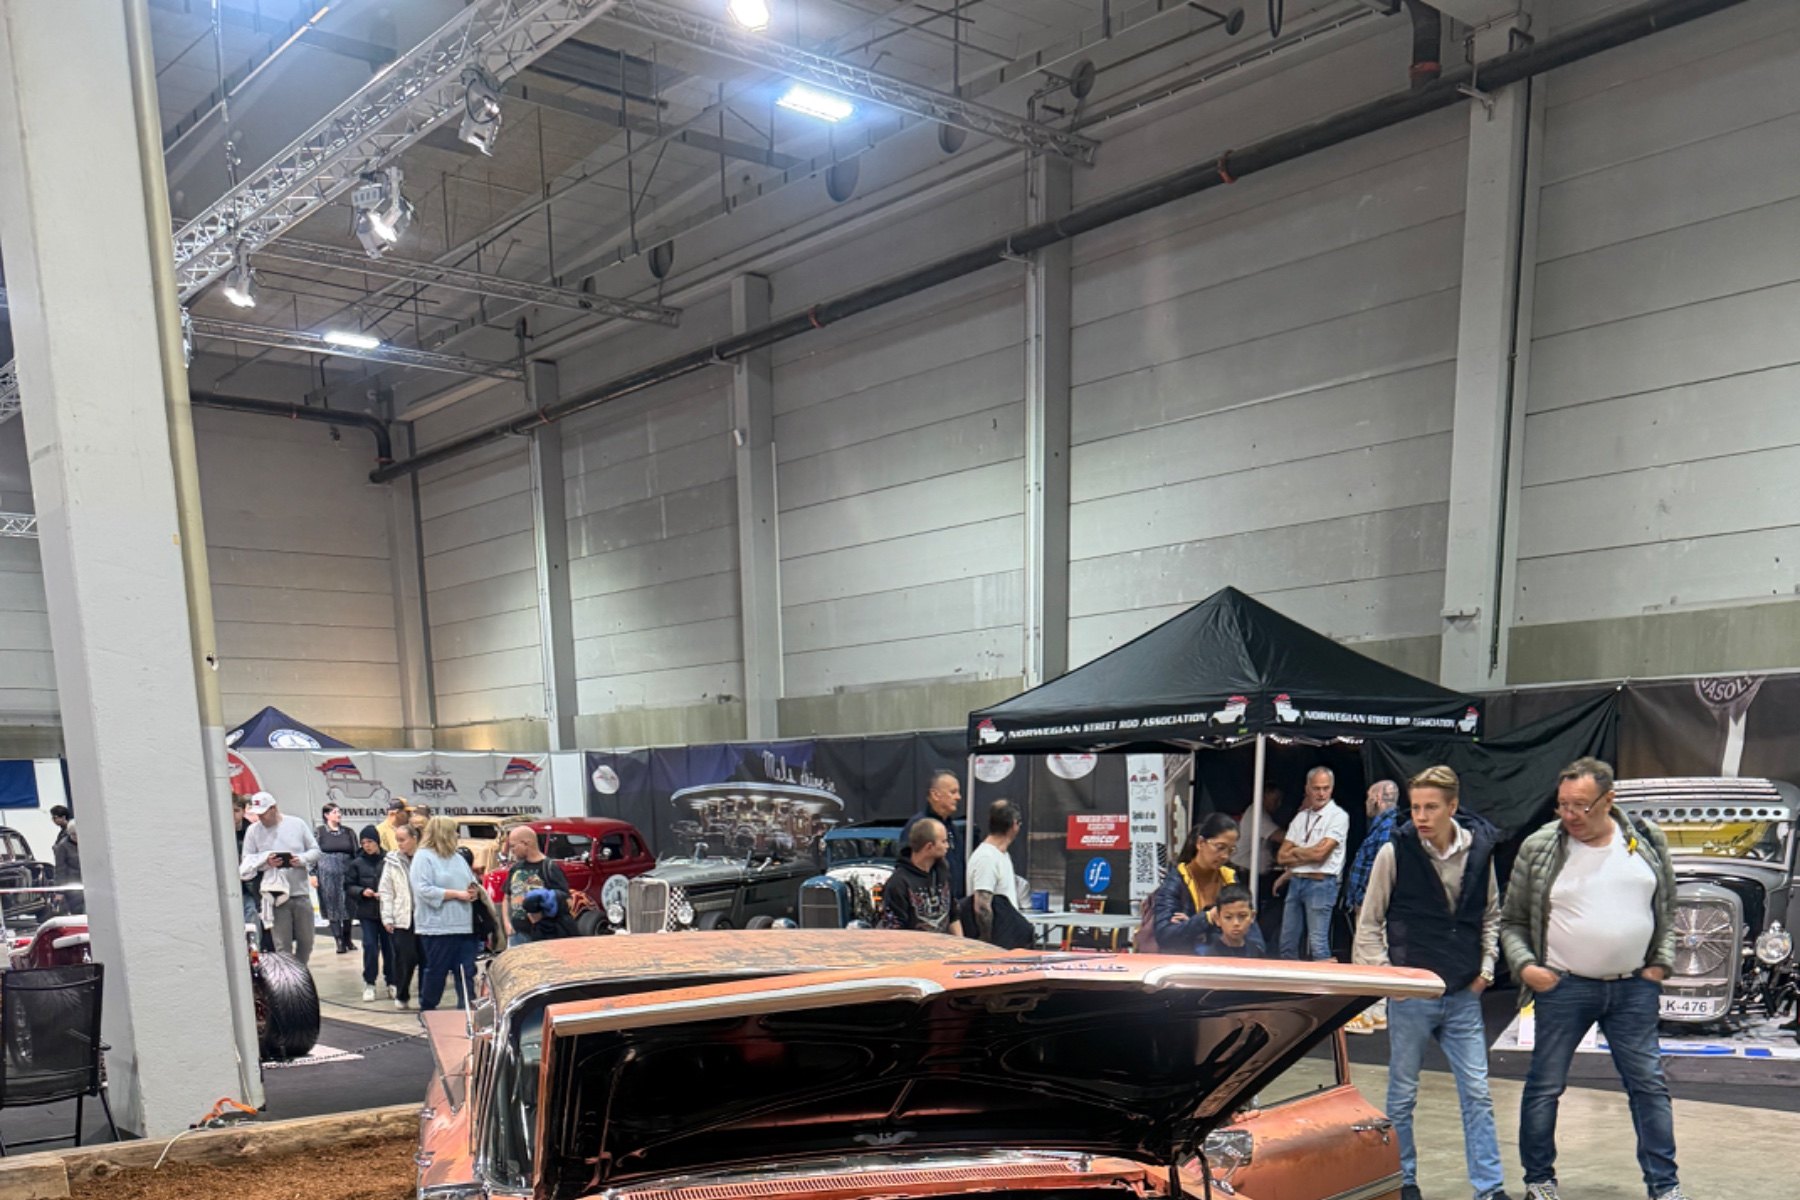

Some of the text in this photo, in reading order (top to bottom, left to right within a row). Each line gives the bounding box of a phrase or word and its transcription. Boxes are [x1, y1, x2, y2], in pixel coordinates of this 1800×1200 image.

[1007, 712, 1208, 739] NORWEGIAN STREET ROD ASSOCIATION
[1304, 710, 1366, 725] NORWEGIAN
[1367, 714, 1394, 726] STREET
[412, 778, 458, 793] NSRA
[443, 806, 468, 815] ROD
[472, 805, 543, 815] ASSOCIATION
[1665, 999, 1708, 1012] K-476
